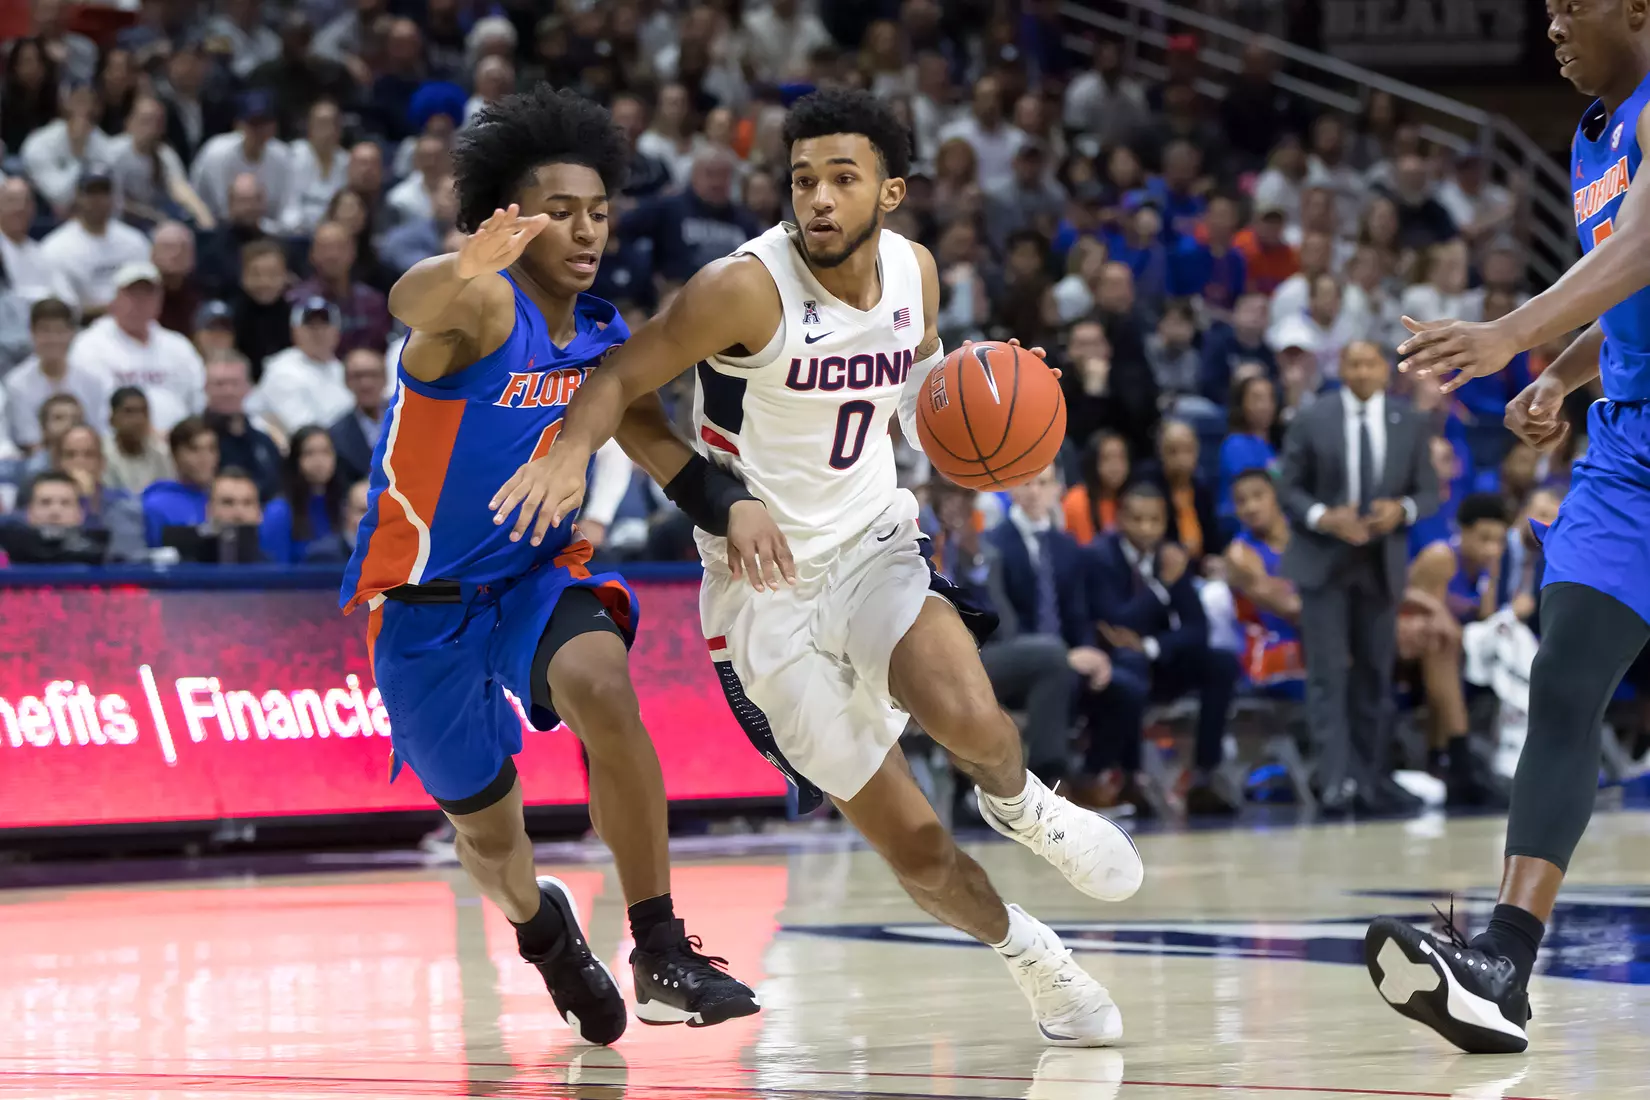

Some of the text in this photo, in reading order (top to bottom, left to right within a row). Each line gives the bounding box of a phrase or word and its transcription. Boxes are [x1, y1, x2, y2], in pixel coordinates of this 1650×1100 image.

[1573, 155, 1630, 227] FLORIDA
[492, 366, 597, 409] FLOR
[829, 399, 876, 471] 0
[175, 674, 392, 742] Financia
